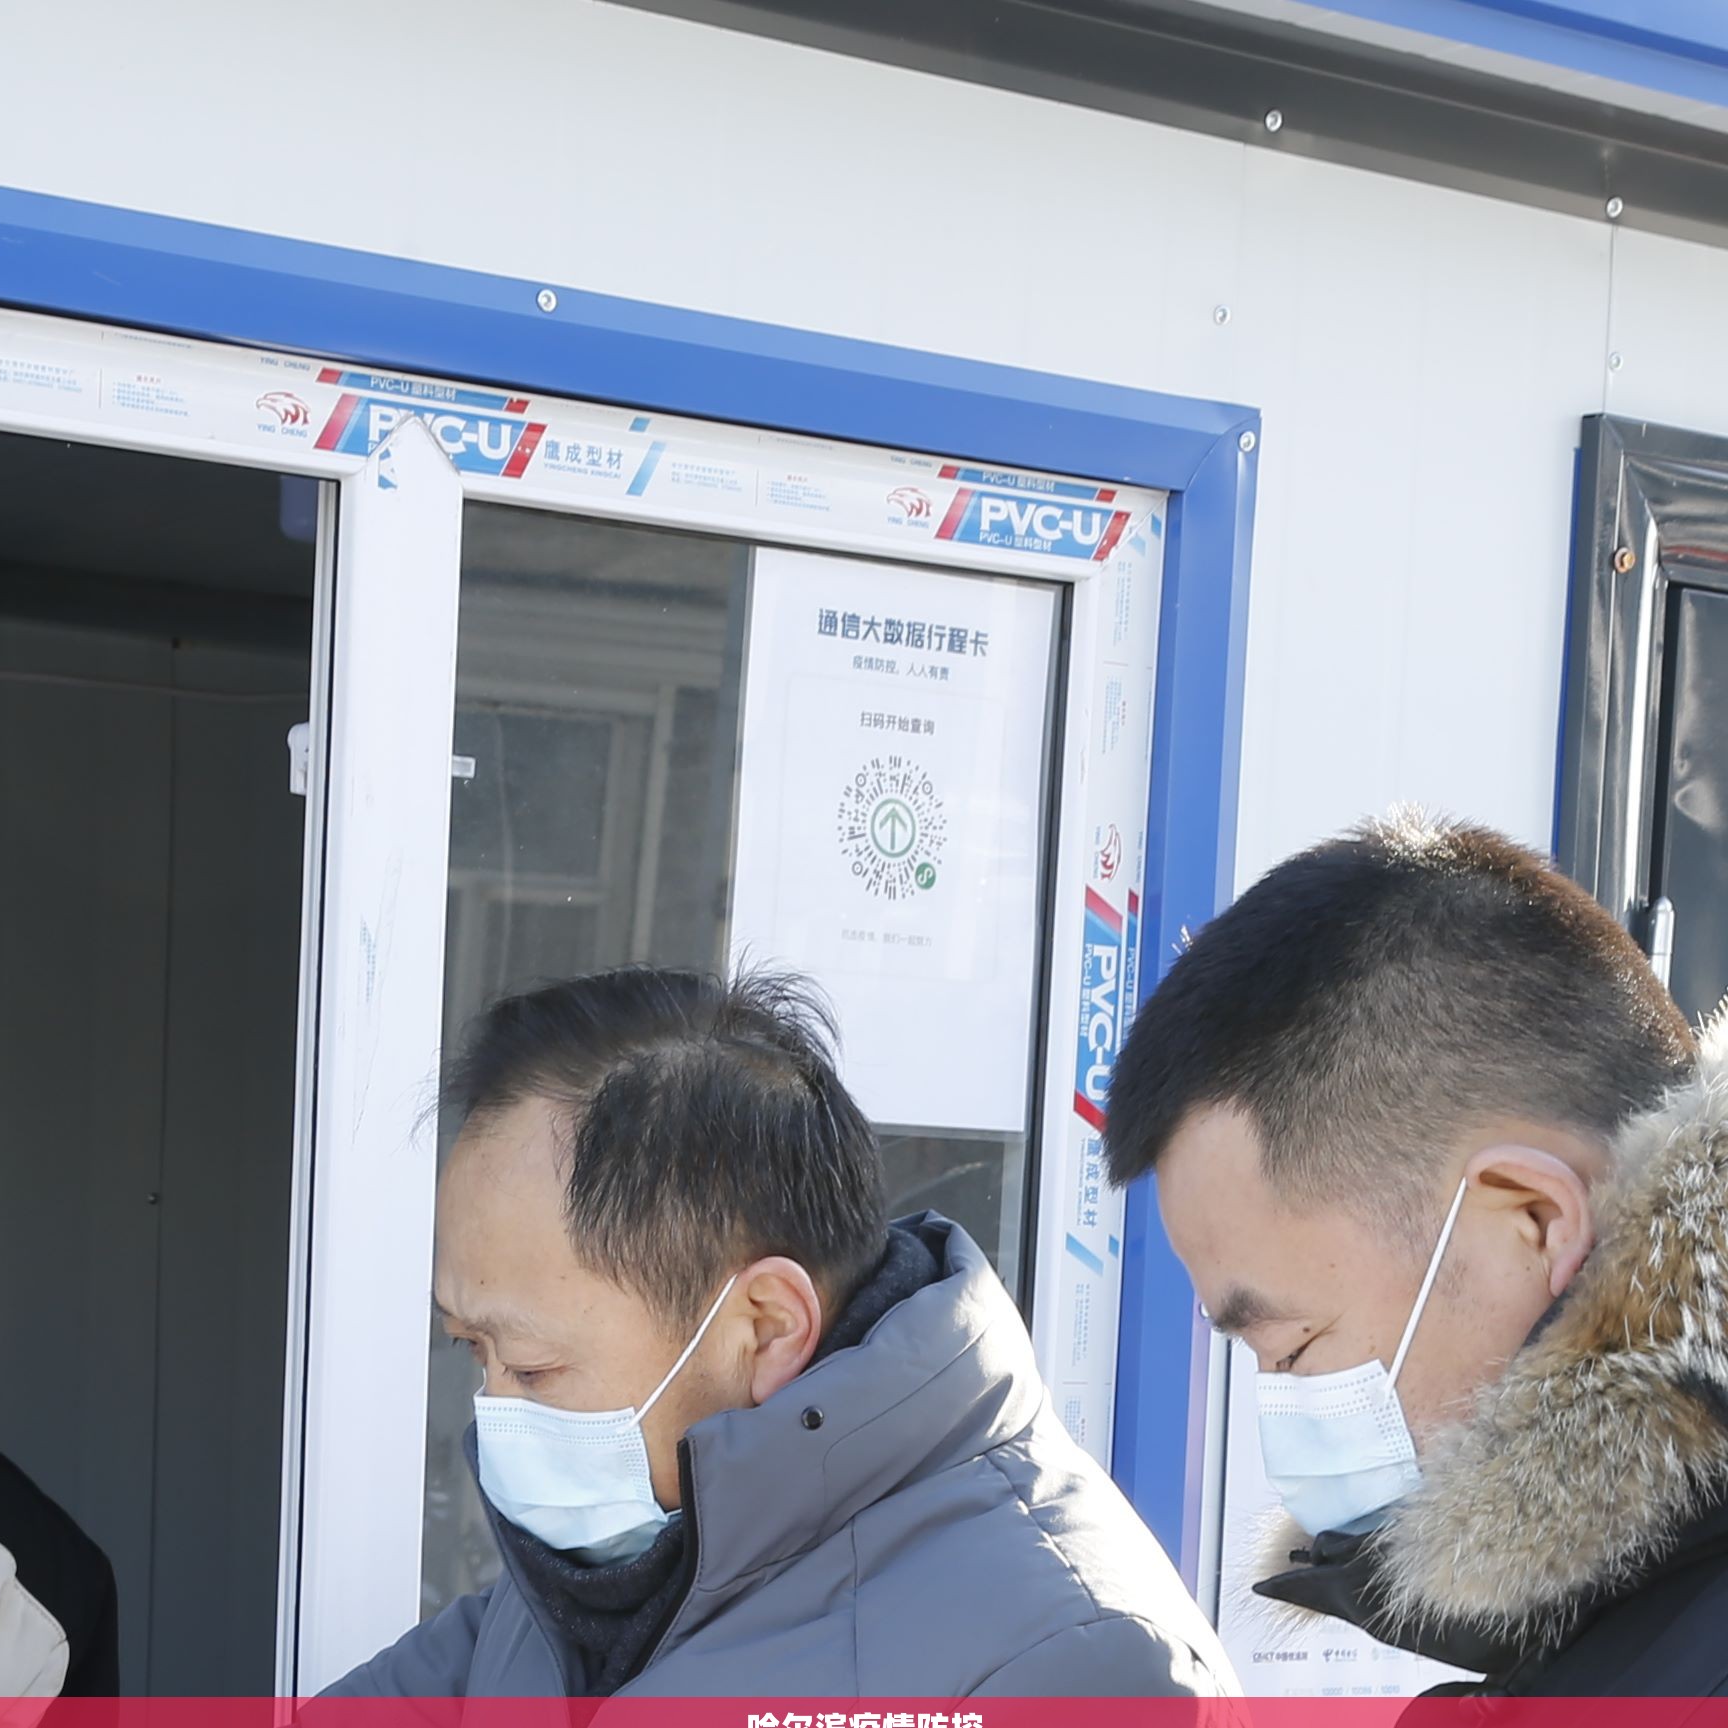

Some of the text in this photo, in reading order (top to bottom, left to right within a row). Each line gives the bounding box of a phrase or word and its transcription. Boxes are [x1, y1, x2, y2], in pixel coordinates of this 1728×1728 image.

[370, 376, 410, 394] PVC-U
[543, 439, 624, 470] 鹰成型材
[982, 472, 1016, 488] PVC-U
[979, 497, 1101, 546] PVC-U
[978, 531, 1012, 546] PVC-U
[818, 608, 989, 657] 通信大数据行程卡
[860, 711, 935, 736] 扫码开始查询
[1085, 943, 1119, 1101] PVC-U
